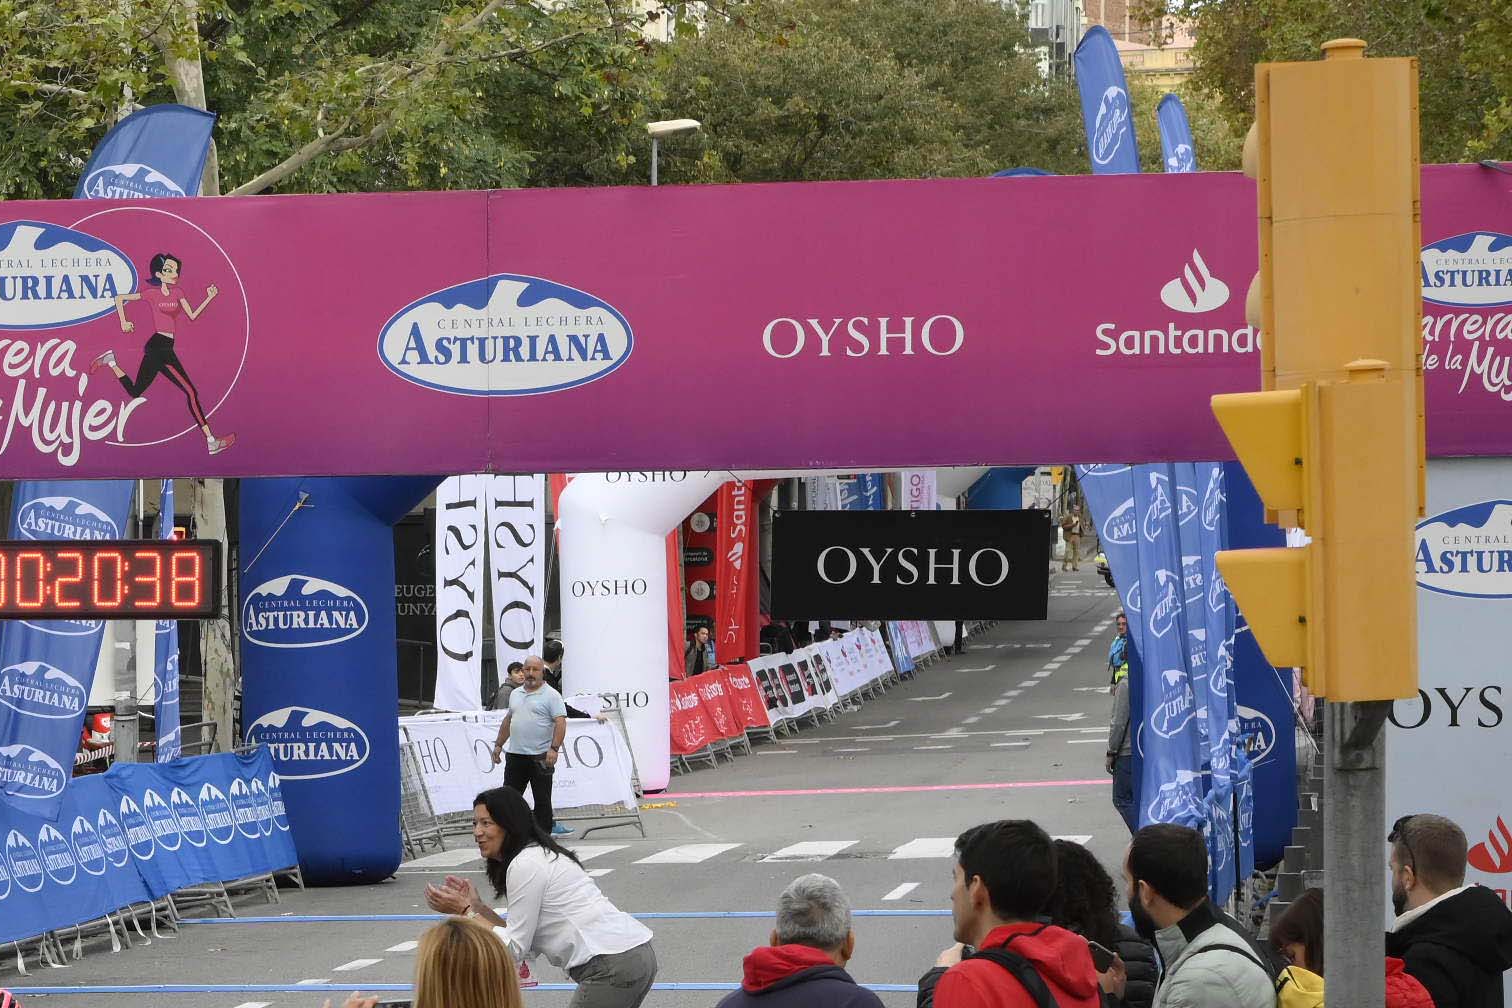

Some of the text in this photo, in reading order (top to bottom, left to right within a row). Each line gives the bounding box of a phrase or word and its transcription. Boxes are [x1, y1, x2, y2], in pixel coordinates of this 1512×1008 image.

[40, 257, 113, 268] LECHERA
[1422, 261, 1512, 288] ASTURIA
[1436, 257, 1487, 266] CENTRAL
[437, 314, 606, 330] CENTRAL LECHERA
[761, 312, 965, 359] OYSHO
[1421, 312, 1512, 342] arrera
[398, 322, 613, 366] ASTURIANA
[1095, 322, 1262, 356] Santand
[1444, 342, 1463, 370] la
[22, 508, 111, 541] ASTURIANA
[1442, 534, 1512, 545] CENTRAL
[816, 546, 1010, 587] OYSHO
[1416, 538, 1512, 575] ASTUR
[571, 577, 648, 599] OYSHO
[246, 602, 359, 632] ASTURIANA
[258, 599, 355, 608] CENTRAL LECHERA
[602, 691, 649, 709] SHO
[1388, 685, 1504, 729] OYS
[260, 731, 355, 740] CENTRAL LECHERA
[267, 742, 360, 761] TURIANA
